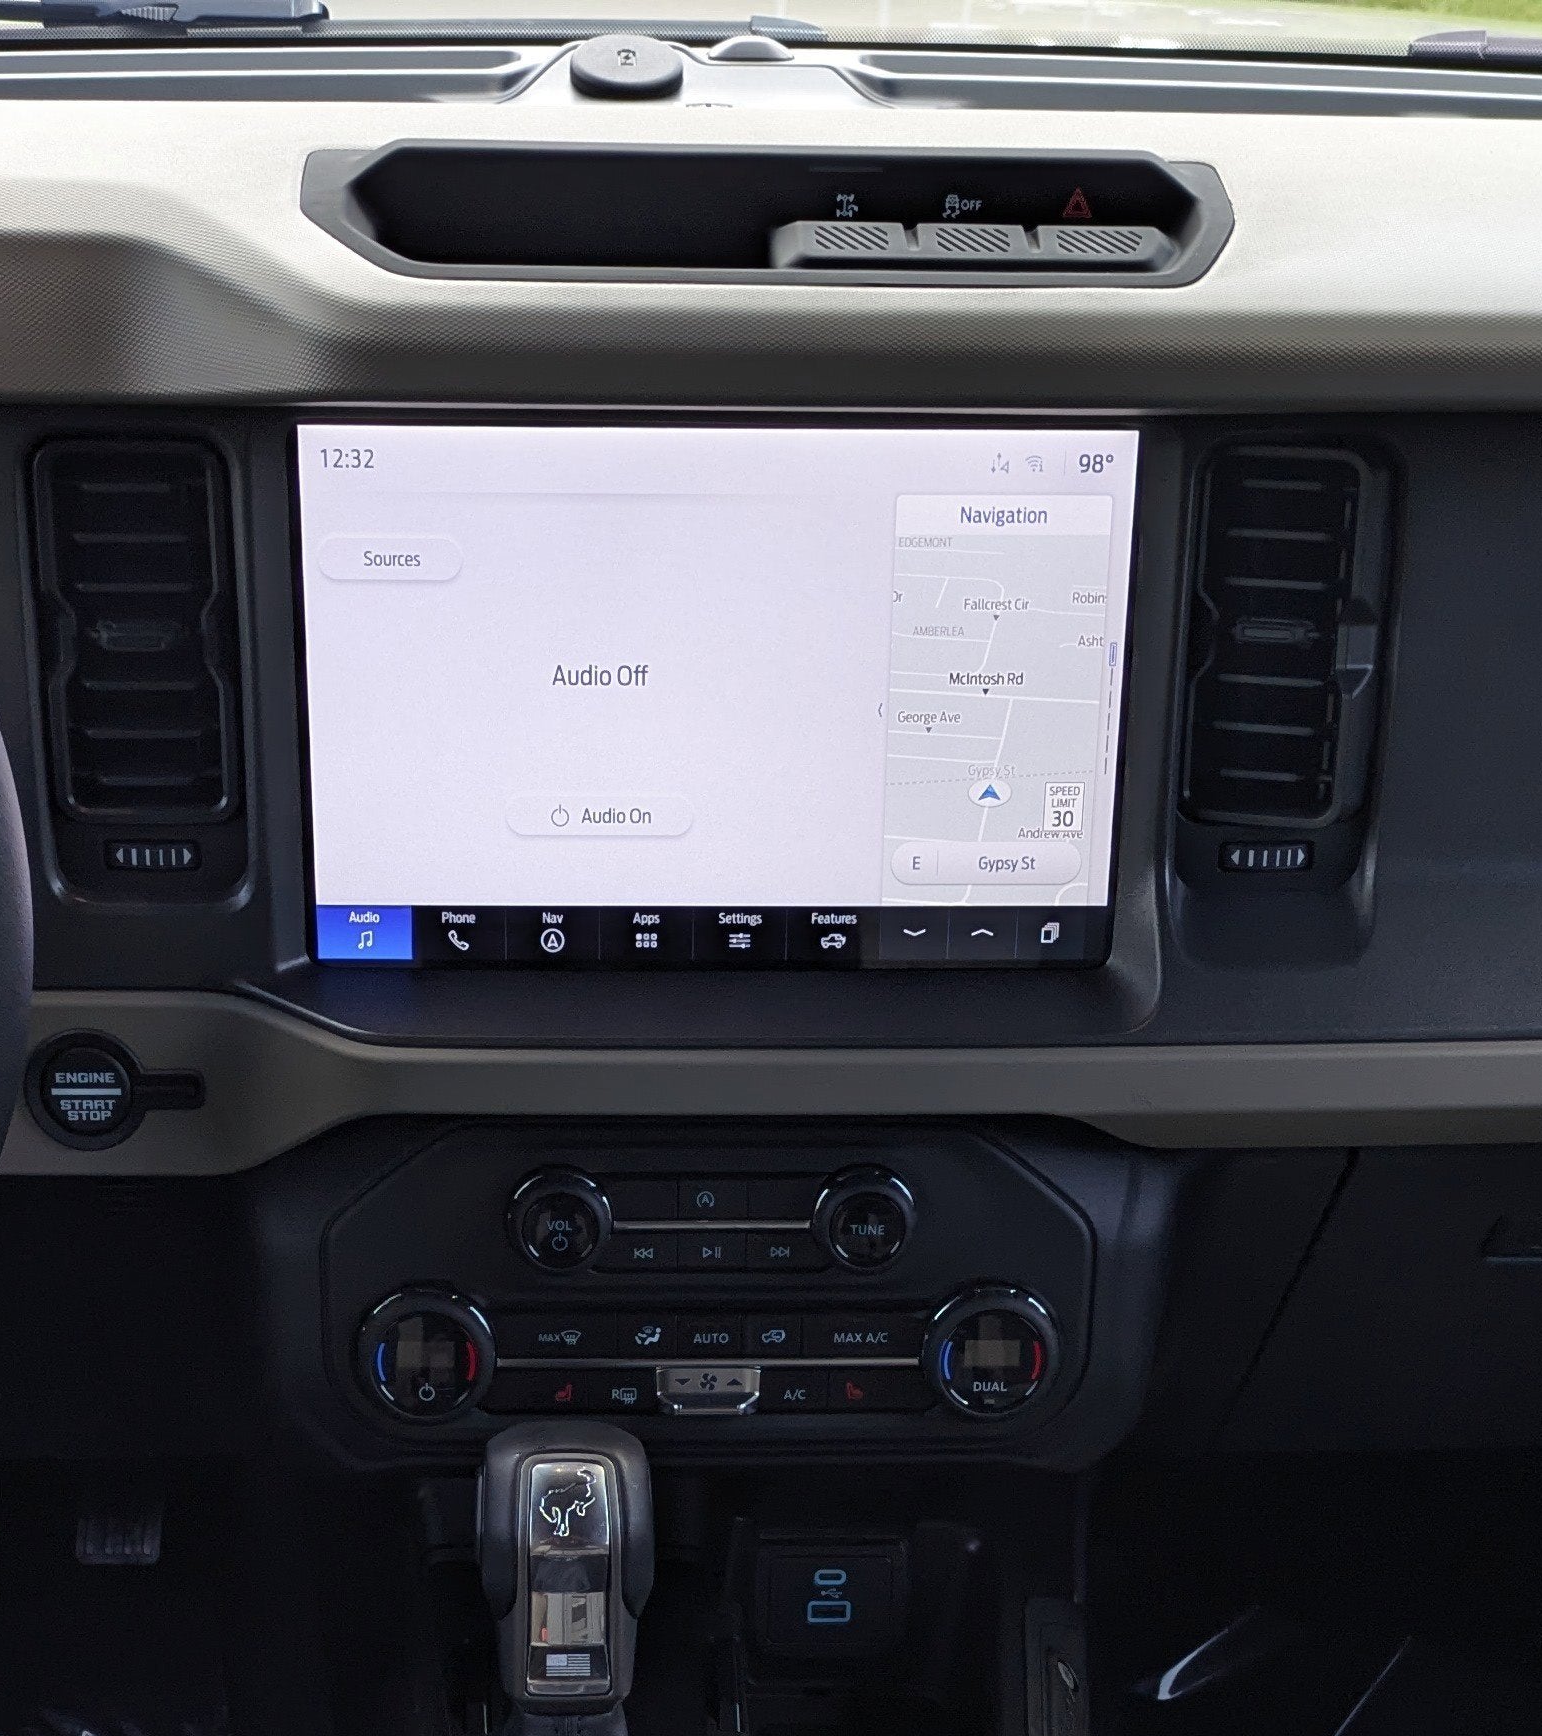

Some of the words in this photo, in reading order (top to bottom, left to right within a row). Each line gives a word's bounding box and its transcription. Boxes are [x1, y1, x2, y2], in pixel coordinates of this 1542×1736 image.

[961, 200, 982, 211] OFF
[320, 448, 375, 469] 12:32
[960, 506, 1048, 527] Navigation
[899, 537, 953, 548] EDGEMONT
[363, 550, 421, 567] Sources
[964, 599, 1012, 611] Fallcrest
[1014, 599, 1029, 610] Cir
[913, 626, 964, 637] AMBERLEA
[552, 664, 612, 686] Audio
[617, 664, 649, 686] Off
[949, 672, 1005, 686] McIntosh
[1007, 672, 1023, 686] Rd
[897, 711, 937, 727] George
[939, 712, 961, 723] Ave
[968, 765, 994, 779] Gypsy
[998, 765, 1015, 776] St
[1049, 786, 1080, 796] SPEED
[1051, 799, 1077, 808] LIMIT
[581, 807, 627, 825] Audio
[629, 808, 652, 825] On
[1052, 811, 1074, 827] 30
[912, 857, 921, 870] E
[978, 857, 1018, 872] Gypsy
[1020, 857, 1035, 870] St
[348, 912, 380, 924] Audio
[441, 912, 476, 924] Phone
[542, 912, 563, 924] Nav
[633, 912, 660, 927] Apps
[718, 912, 762, 927] Settings
[811, 912, 857, 925] Features
[55, 1072, 116, 1084] ENGINE
[60, 1100, 117, 1111] START
[67, 1111, 112, 1121] STOP
[546, 1220, 572, 1232] VOL
[849, 1224, 885, 1236] TUNE
[539, 1333, 560, 1344] MAX
[693, 1333, 729, 1344] AUTO
[833, 1333, 863, 1343] MAX
[865, 1332, 888, 1343] A/C
[973, 1381, 1007, 1392] DUAL
[784, 1389, 806, 1400] A/C
